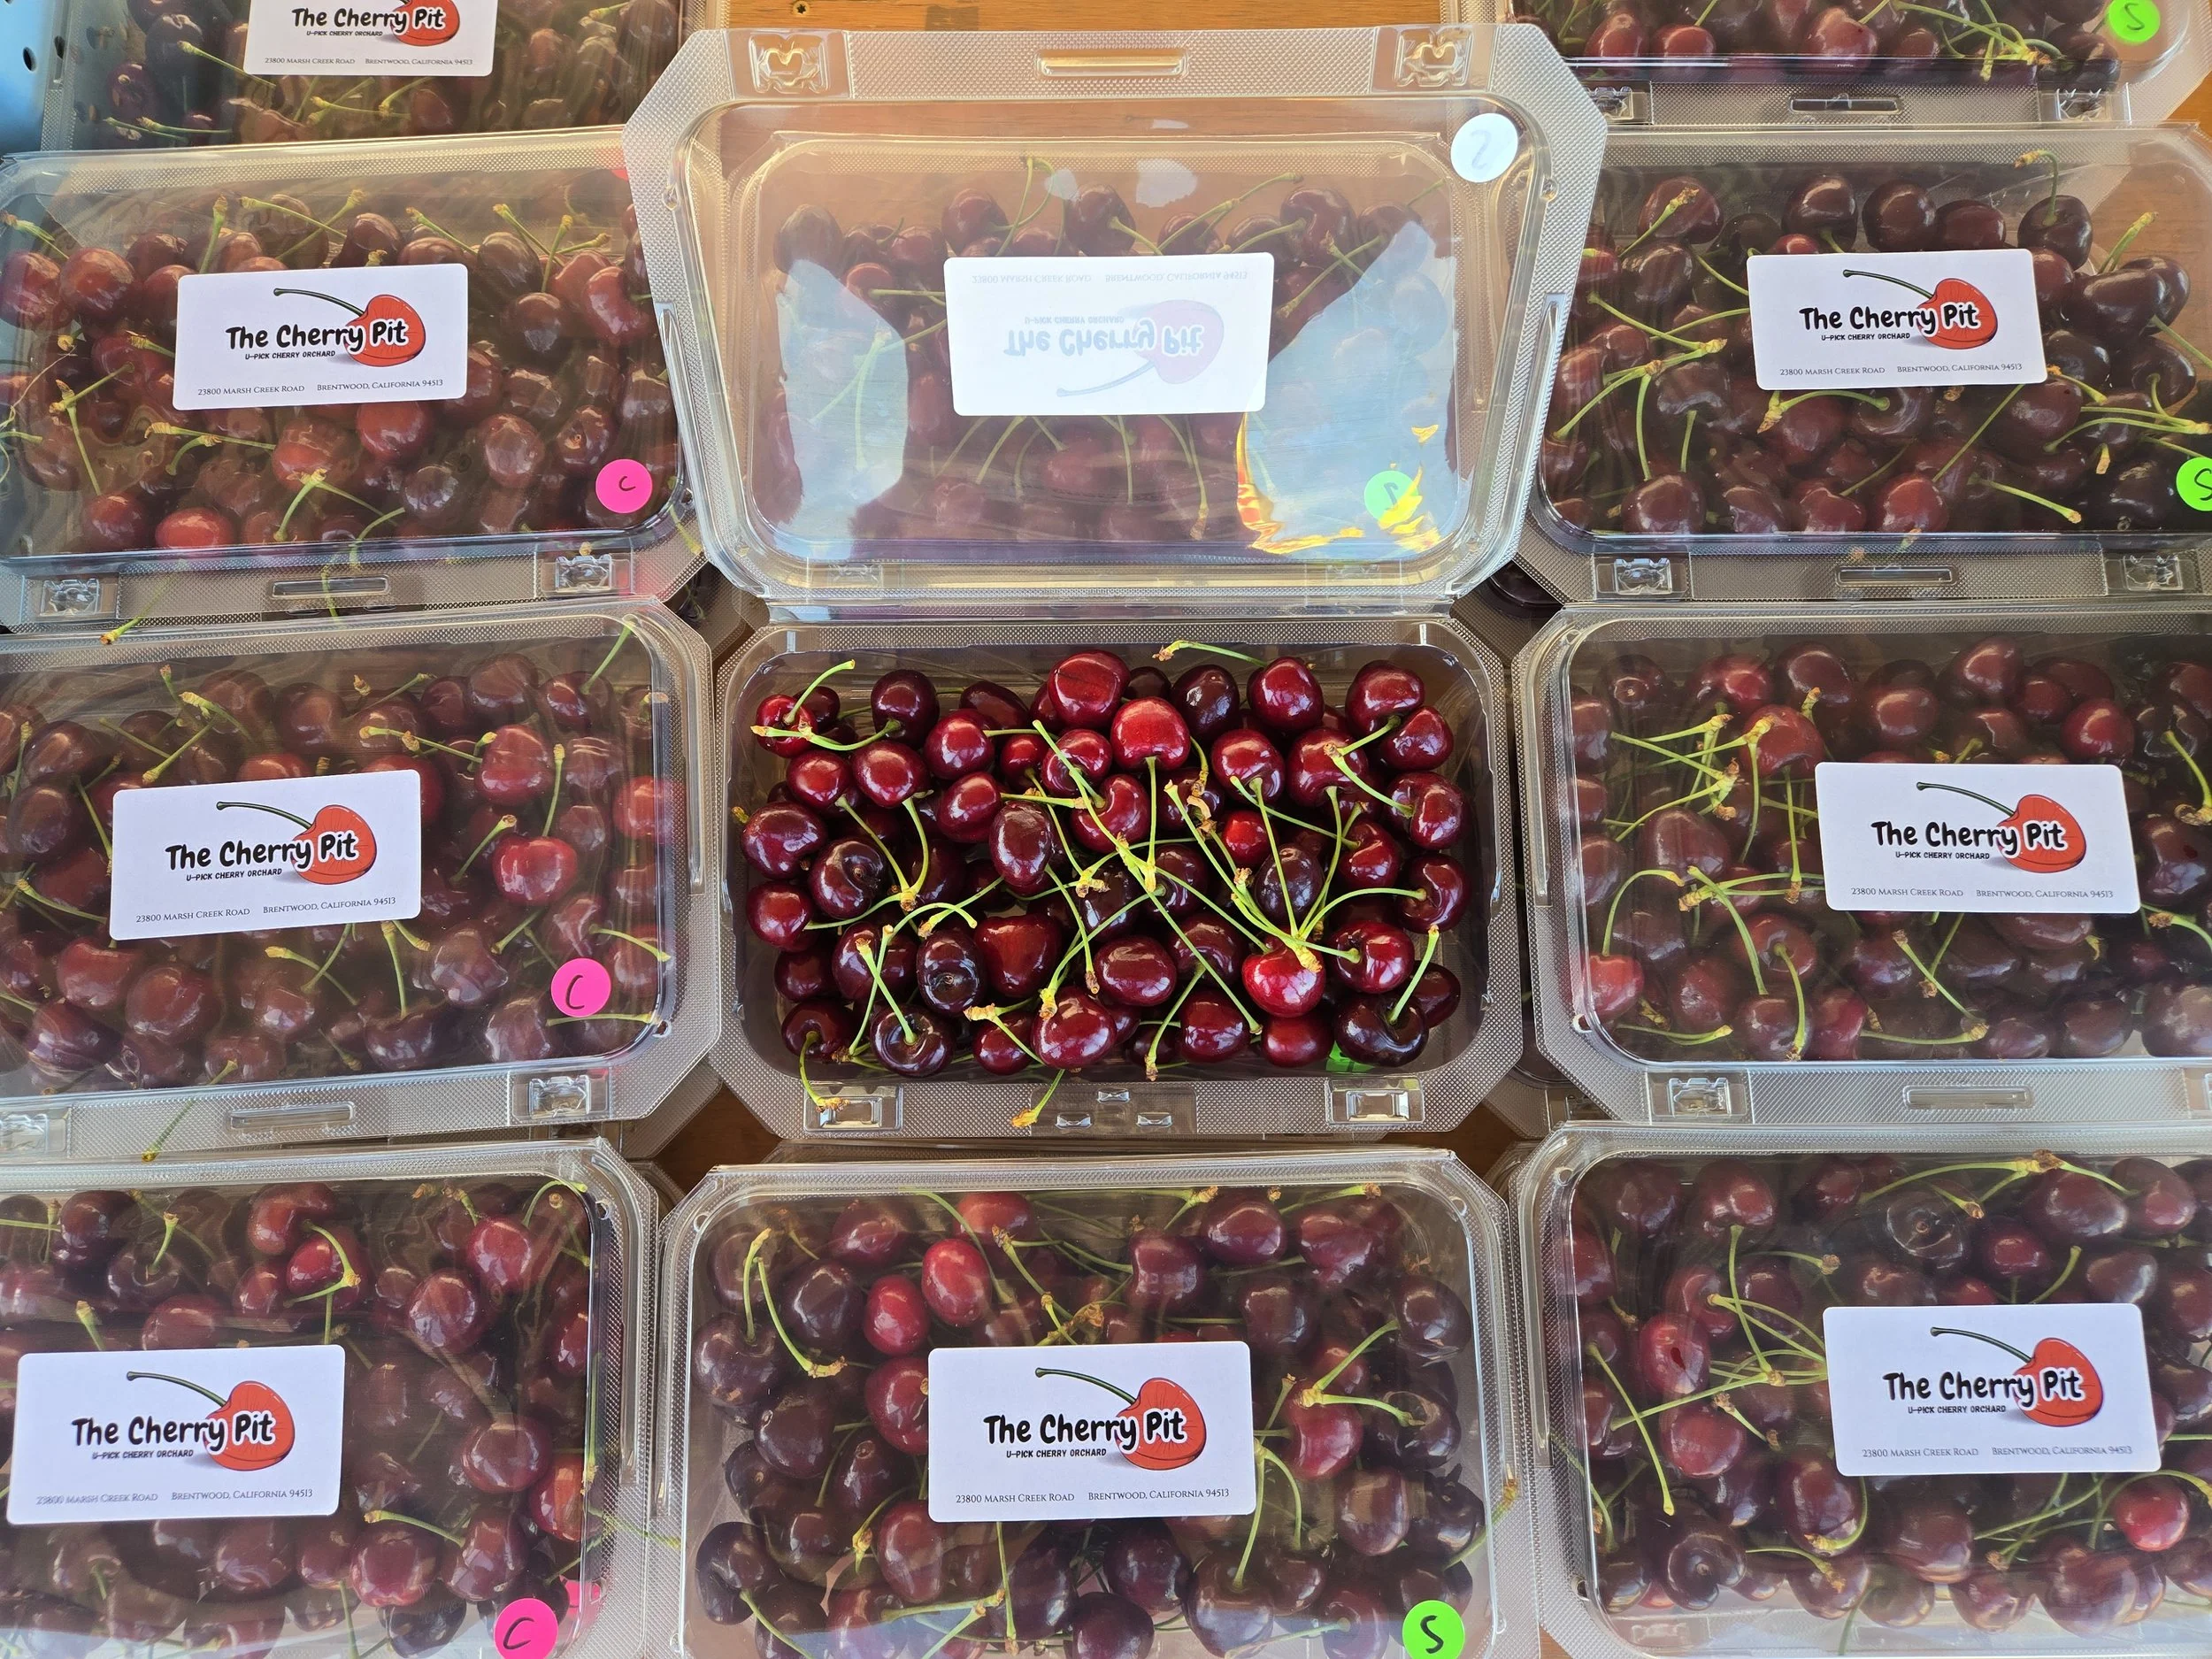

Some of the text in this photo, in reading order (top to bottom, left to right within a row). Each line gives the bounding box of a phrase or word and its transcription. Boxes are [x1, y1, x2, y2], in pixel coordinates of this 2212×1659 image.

[292, 8, 443, 32] The Cherry Pit
[2124, 3, 2145, 31] S
[1799, 304, 1978, 334] The Cherry Pit
[226, 321, 406, 351] The Cherry Pit
[618, 475, 636, 492] C
[165, 834, 356, 871] The Cherry Pit
[1870, 822, 2063, 856] The Cherry Pit
[186, 872, 212, 881] U-PICK
[136, 914, 161, 923] 23800
[164, 912, 194, 921] MARSH
[196, 910, 224, 918] CREEK
[263, 897, 396, 914] BRENTWOOD, CALIFORNIA 94513
[565, 974, 585, 1010] C
[1882, 1371, 2080, 1407] The Cherry Pit
[72, 1414, 273, 1451] The Cherry Pit
[983, 1412, 1184, 1450] The Cherry Pit
[92, 1450, 120, 1460] U-PICK
[157, 1449, 193, 1458] ORCHARD
[956, 1494, 981, 1503] 23800
[1088, 1489, 1229, 1501] BRENTWOOD, CALIFORNIA 94513
[503, 1617, 535, 1650] C
[1420, 1615, 1444, 1654] S
